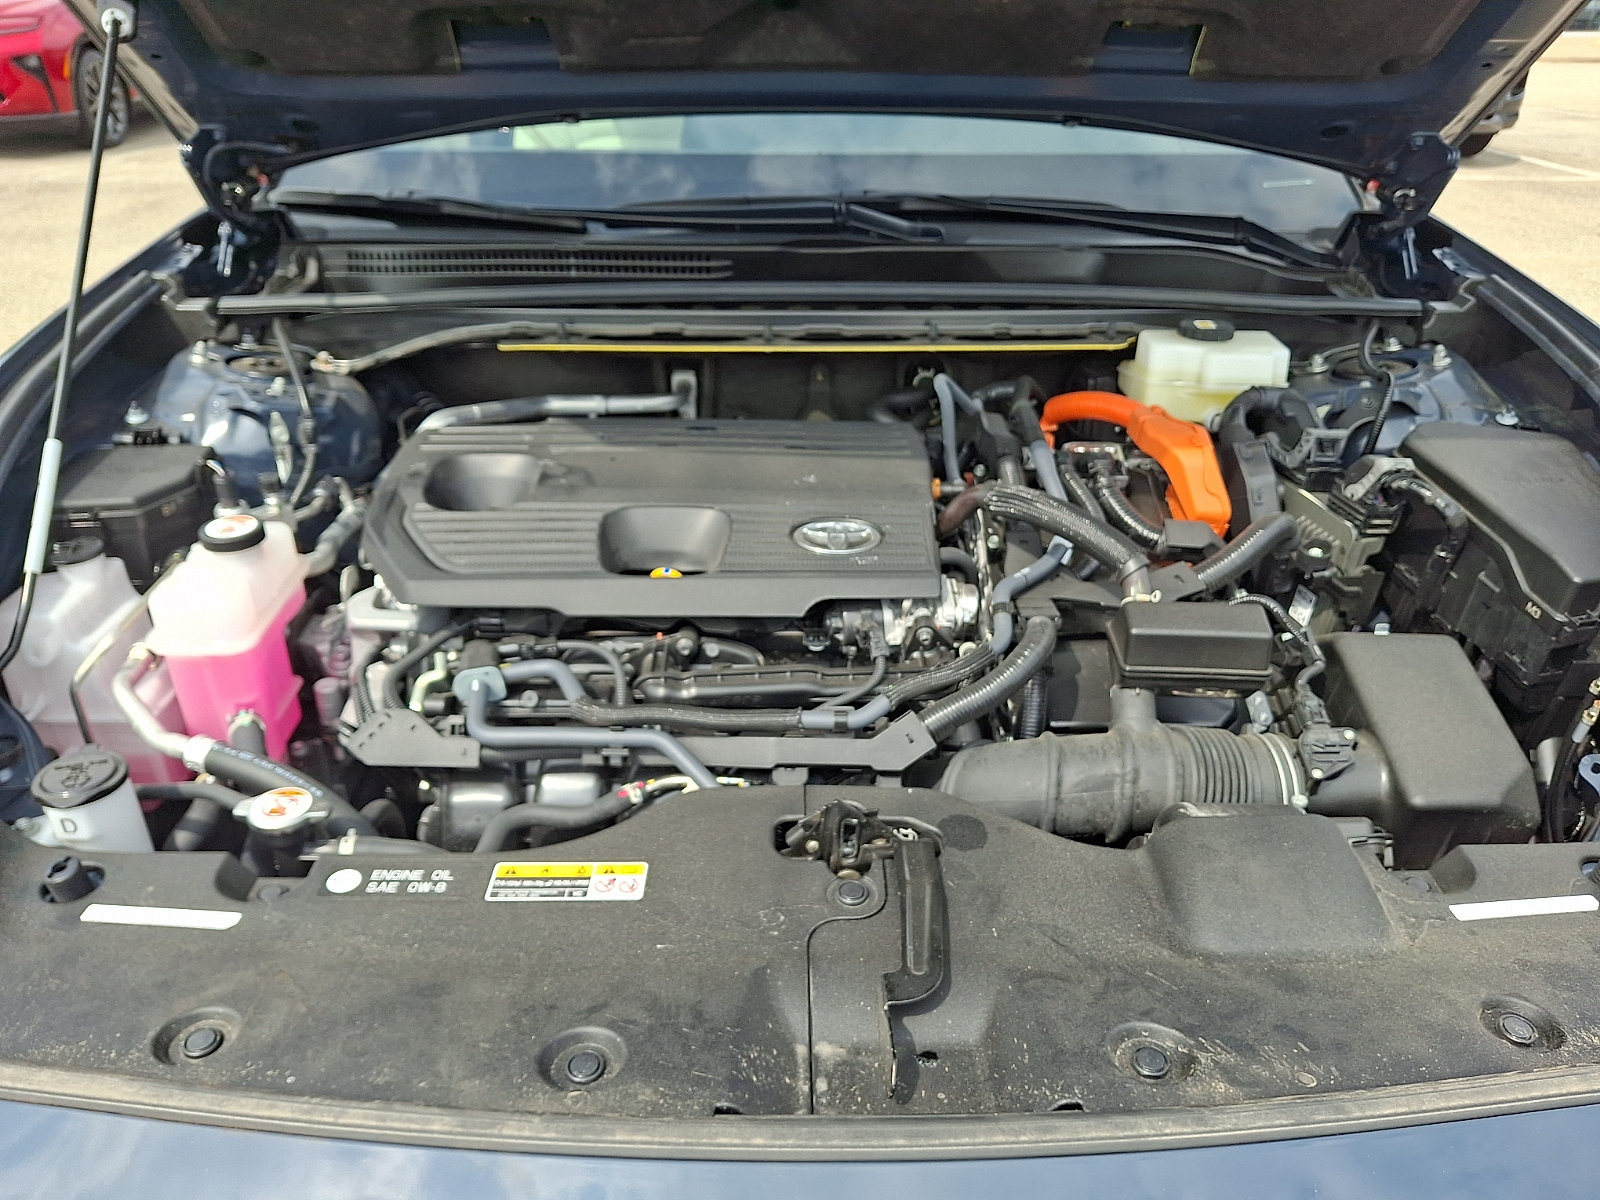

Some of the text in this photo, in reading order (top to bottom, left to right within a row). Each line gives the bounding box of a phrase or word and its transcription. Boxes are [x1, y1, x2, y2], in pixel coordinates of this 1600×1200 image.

[60, 818, 77, 833] D
[369, 869, 454, 881] ENGINE OIL
[364, 881, 400, 893] SAE
